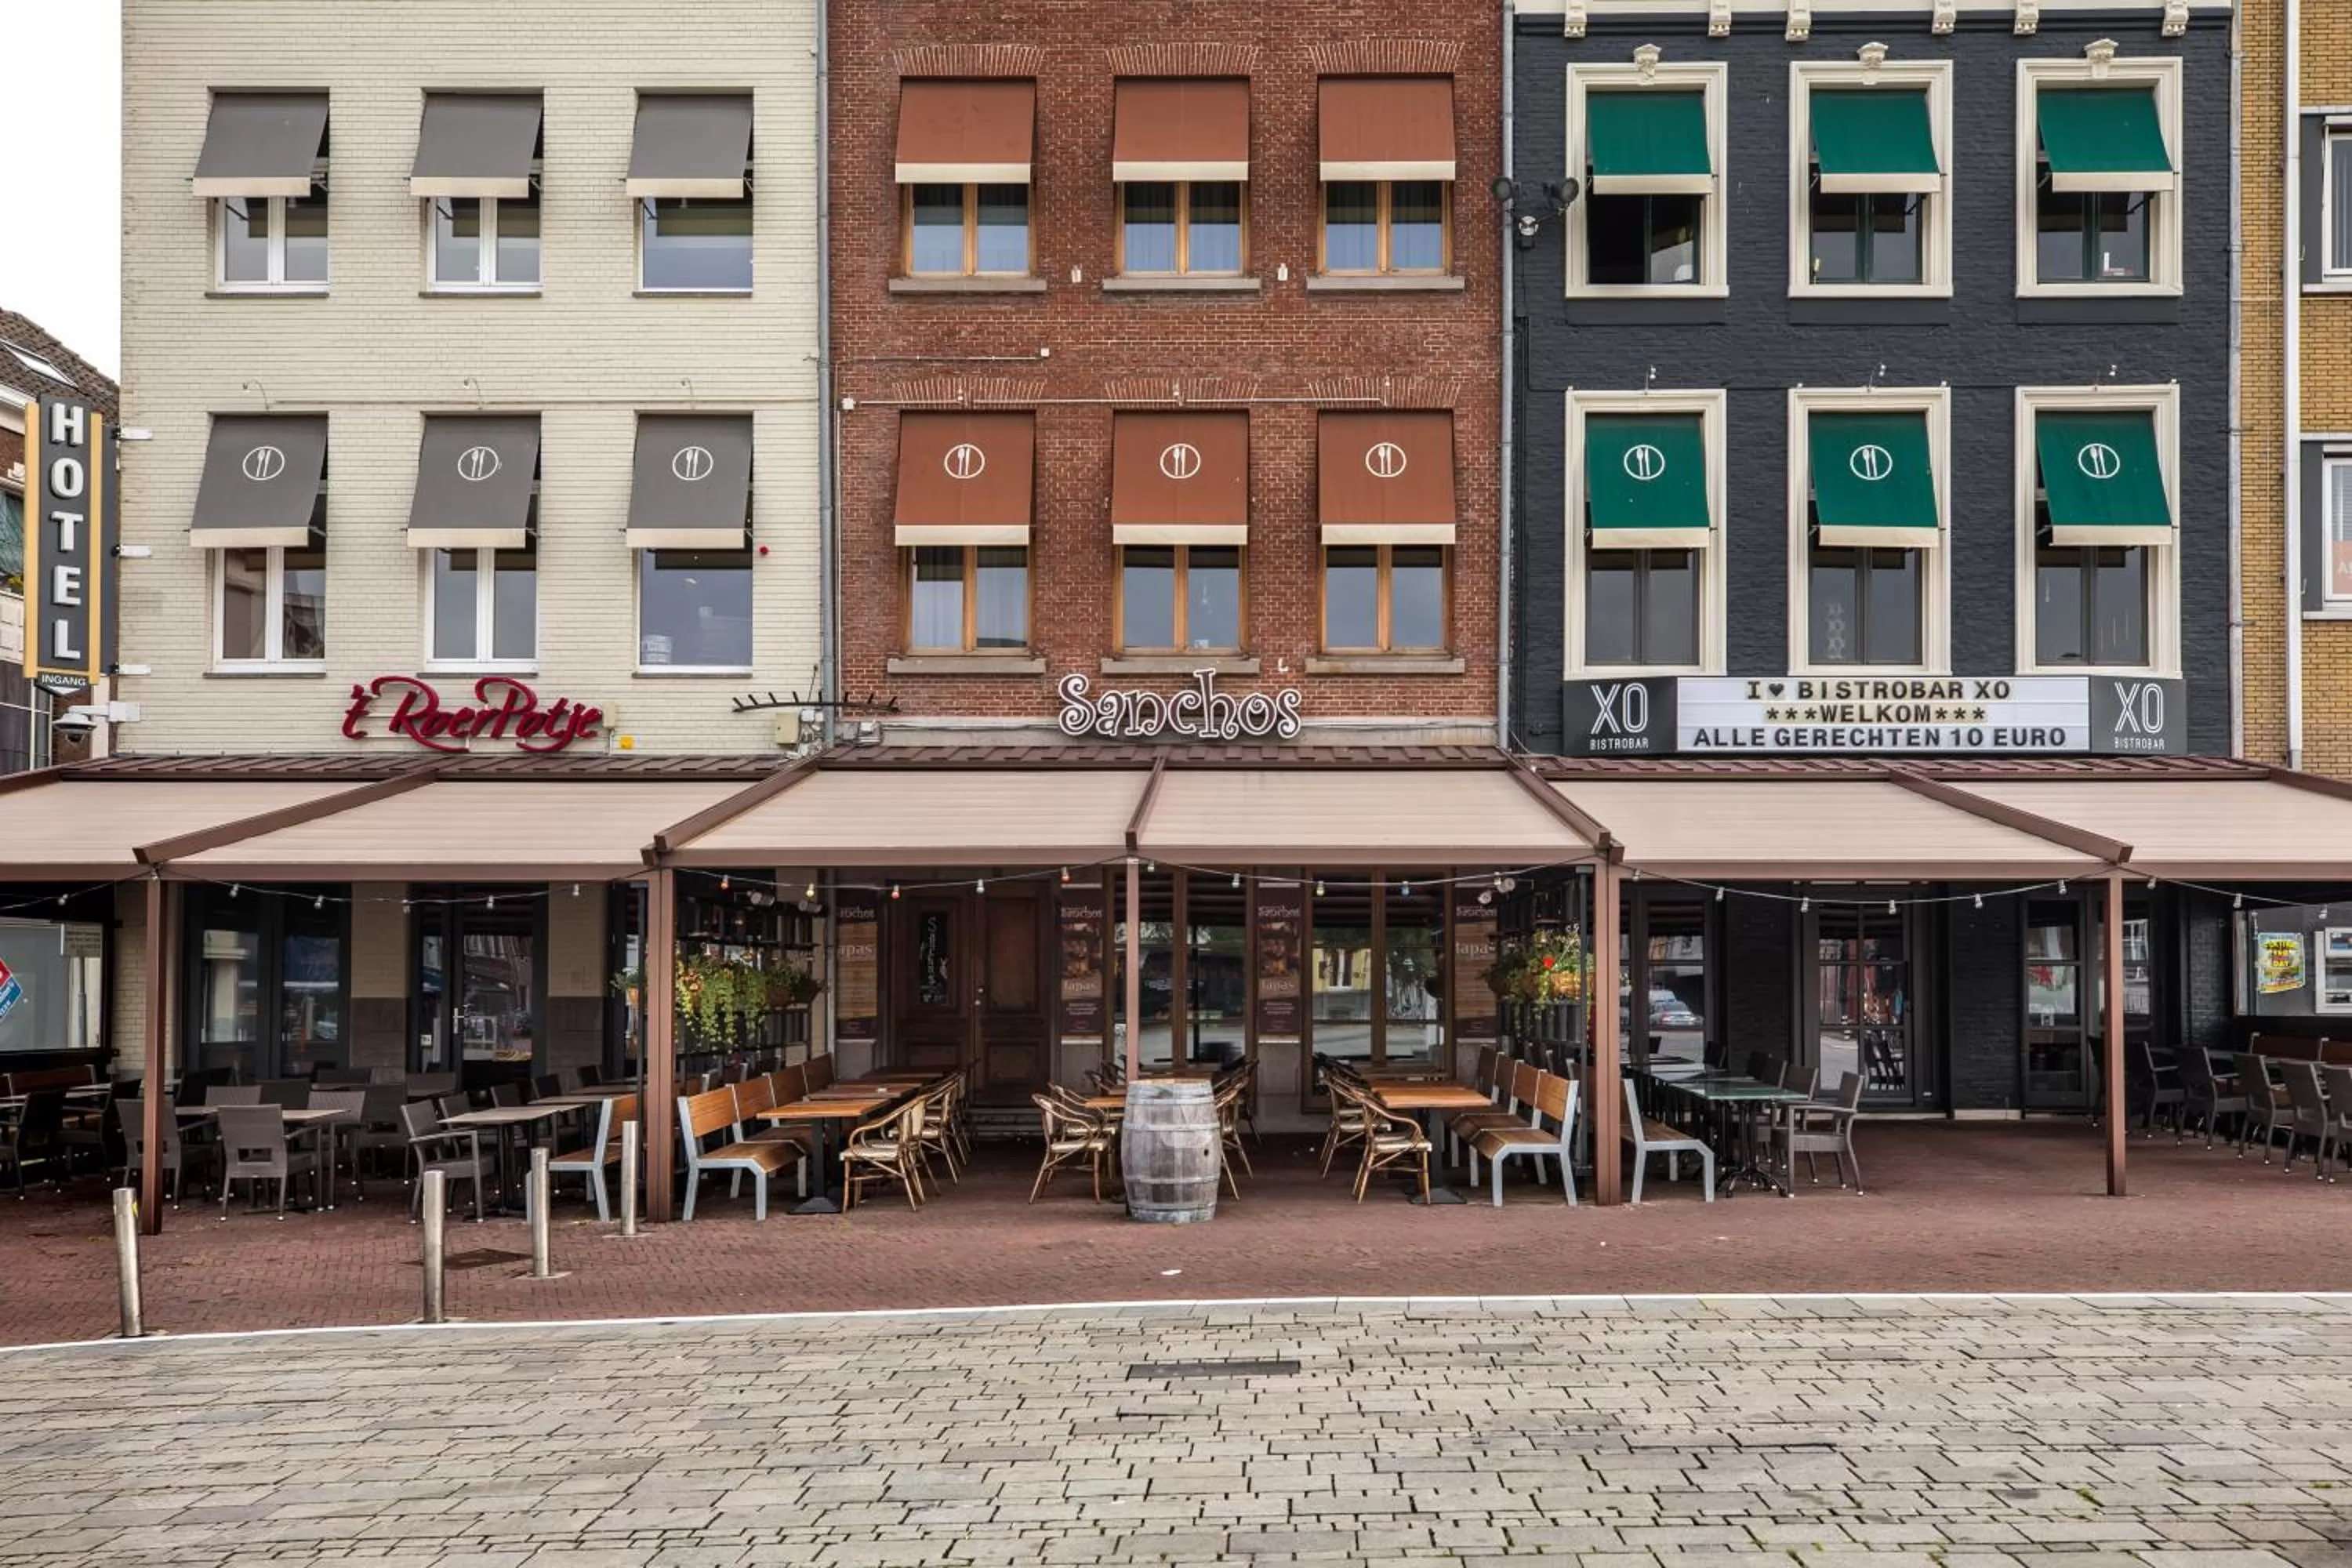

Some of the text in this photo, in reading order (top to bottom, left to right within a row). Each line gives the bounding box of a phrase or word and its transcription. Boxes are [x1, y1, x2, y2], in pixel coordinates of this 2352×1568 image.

[50, 402, 84, 660] HOTEL
[42, 673, 86, 687] INGANG
[1748, 681, 2010, 699] I BISTROBAR XO
[1059, 668, 1301, 739] Sanchos
[1591, 683, 1648, 734] XO
[2114, 682, 2163, 733] XO
[370, 676, 603, 753] RoerPotje
[1590, 738, 1649, 750] BISTROBAR
[1693, 728, 2066, 746] ALLE GERECHTEN 10 EURO
[2114, 737, 2165, 750] BISTROBAR
[837, 943, 873, 959] apas
